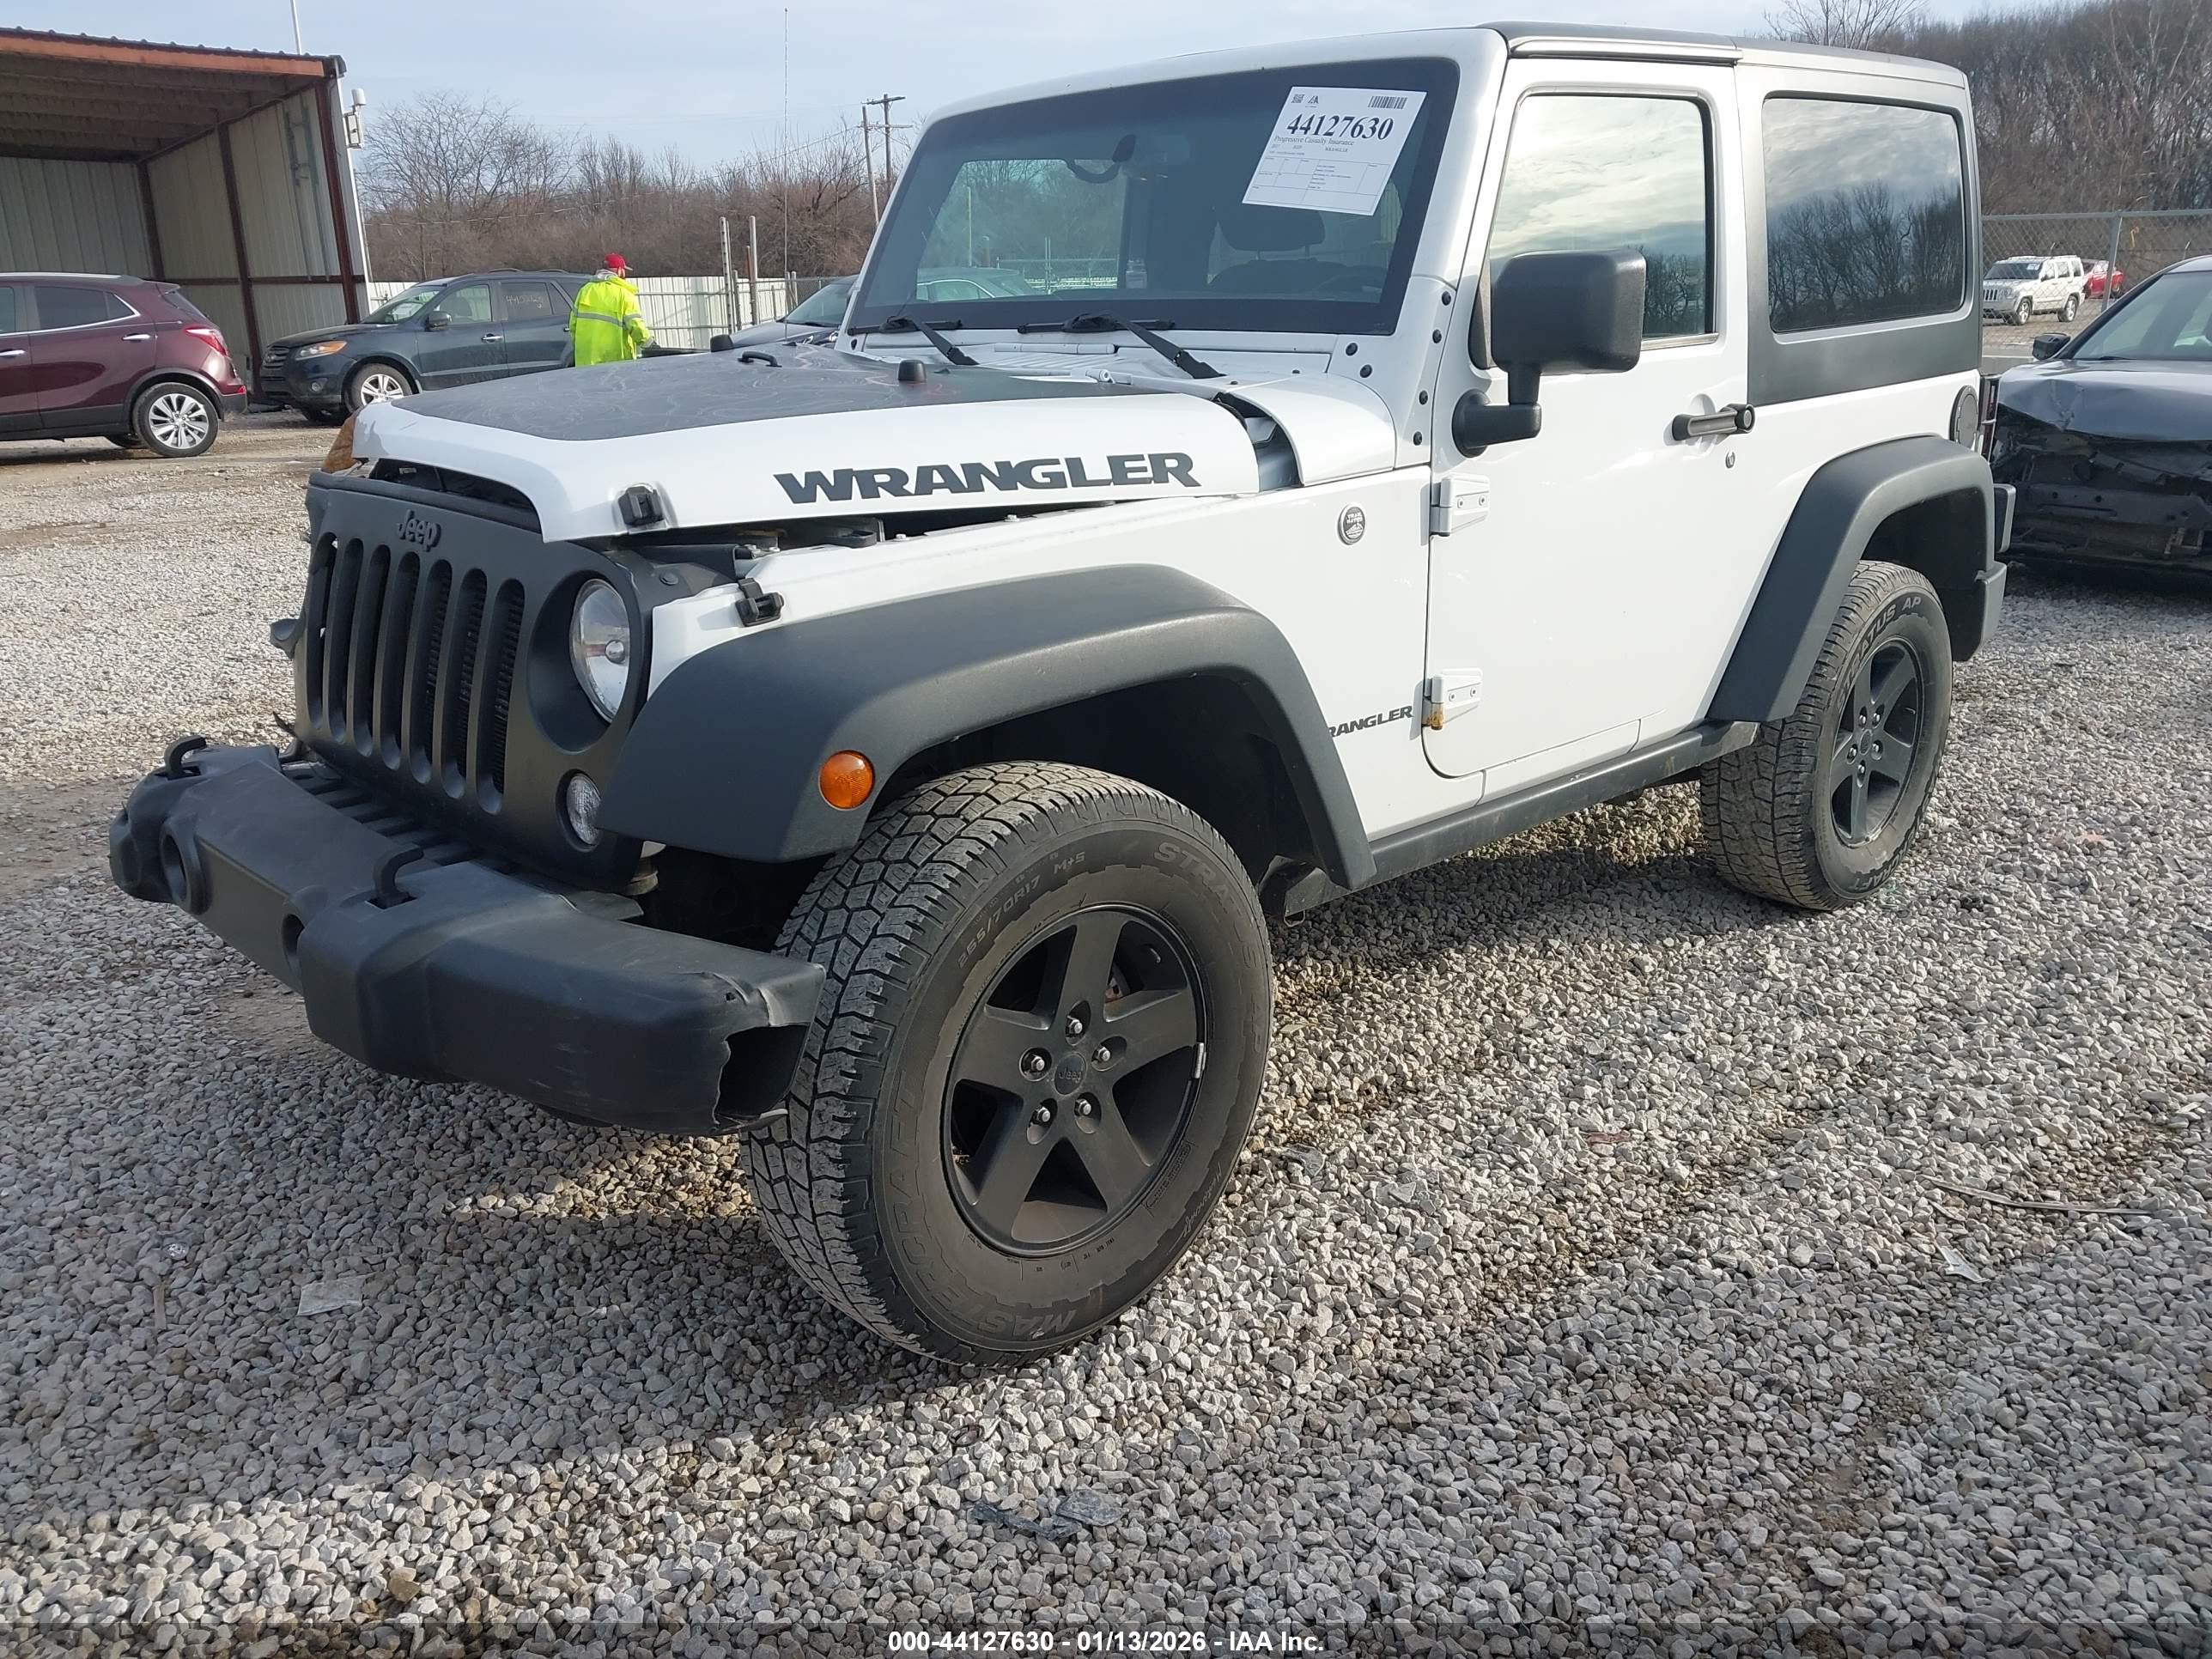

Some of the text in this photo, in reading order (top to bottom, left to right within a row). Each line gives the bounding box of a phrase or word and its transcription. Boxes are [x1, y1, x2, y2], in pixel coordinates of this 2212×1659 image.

[1274, 136, 1304, 144] Progressive
[1328, 138, 1354, 147] Insurance
[1286, 113, 1395, 140] 44127630
[773, 452, 1202, 504] WRANGLER
[397, 509, 441, 552] Jeep
[1901, 597, 1922, 611] AP
[1328, 705, 1414, 738] RANGLER
